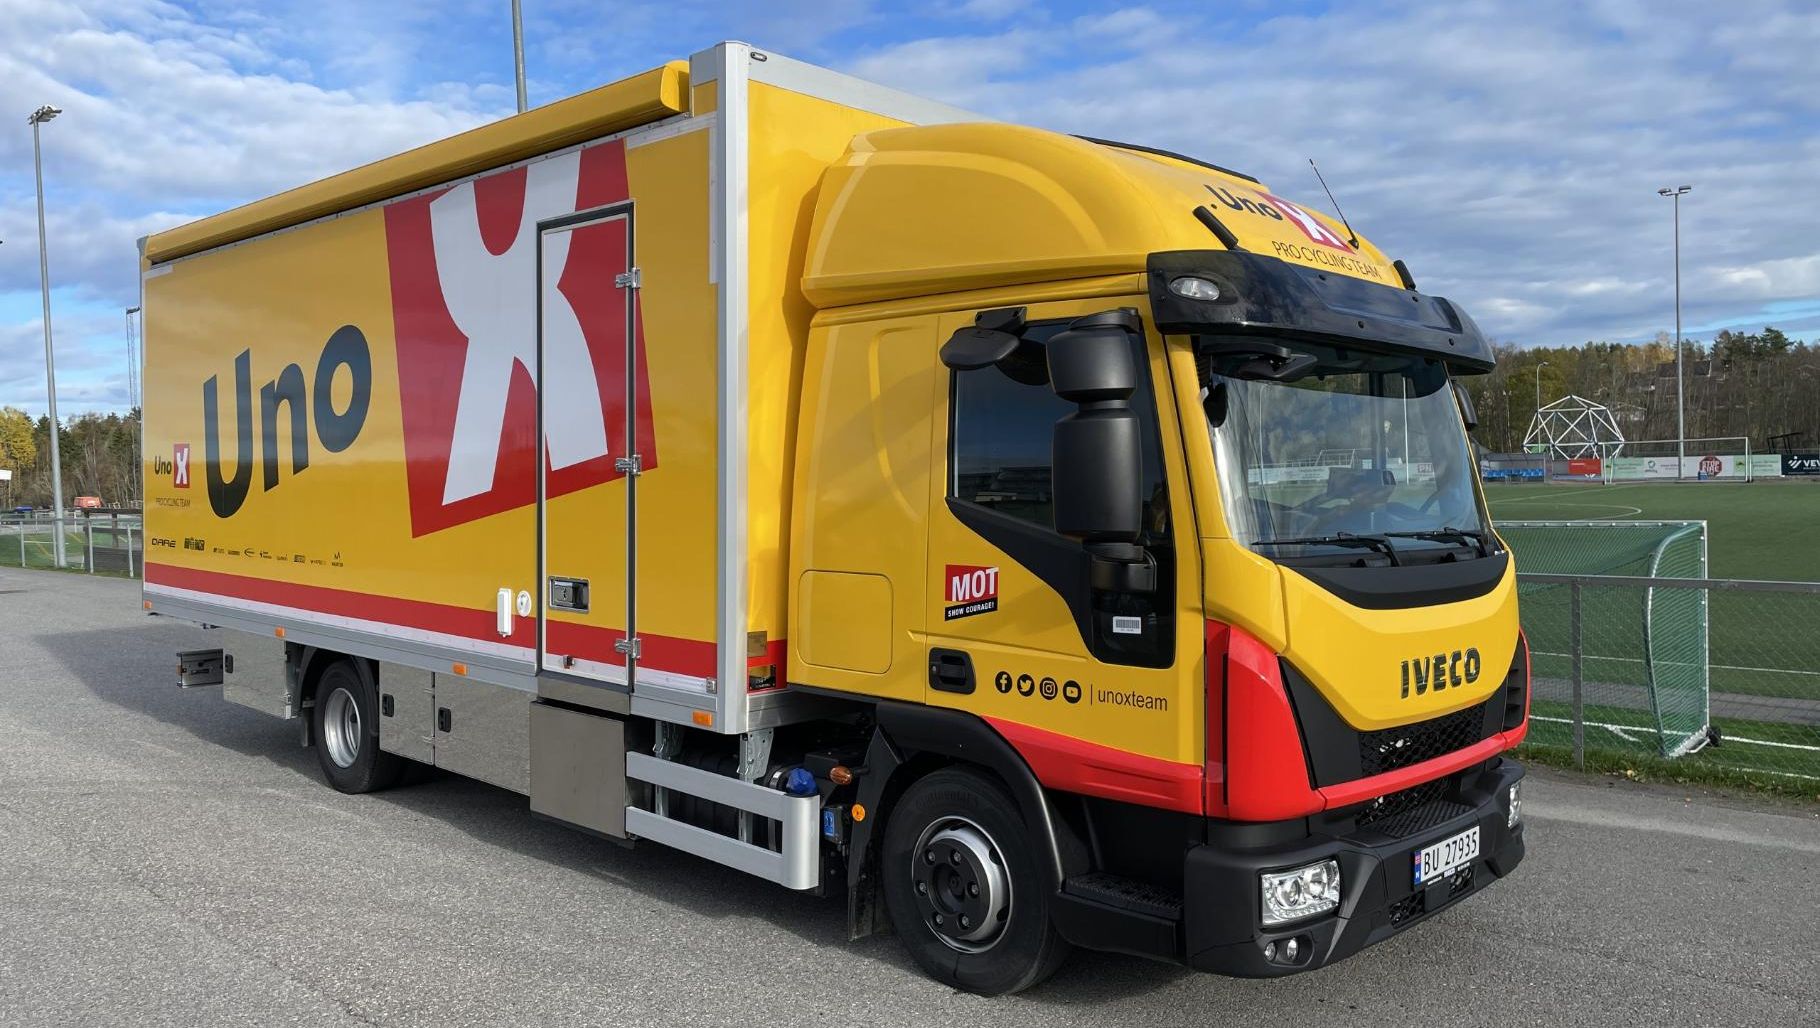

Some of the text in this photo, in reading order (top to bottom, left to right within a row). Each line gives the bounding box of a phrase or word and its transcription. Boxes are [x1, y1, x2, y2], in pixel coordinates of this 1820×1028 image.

[1203, 183, 1283, 221] Uno
[1271, 240, 1383, 280] PRO CYCLING TEAM
[203, 149, 609, 518] Uno X
[154, 447, 188, 485] Uno X
[951, 567, 1000, 602] MOT
[948, 601, 995, 617] SHOW COURAGE!
[1400, 647, 1481, 700] IVECO
[1097, 688, 1168, 712] unoxteam
[1424, 846, 1441, 876] BU
[1445, 830, 1478, 867] 27935
